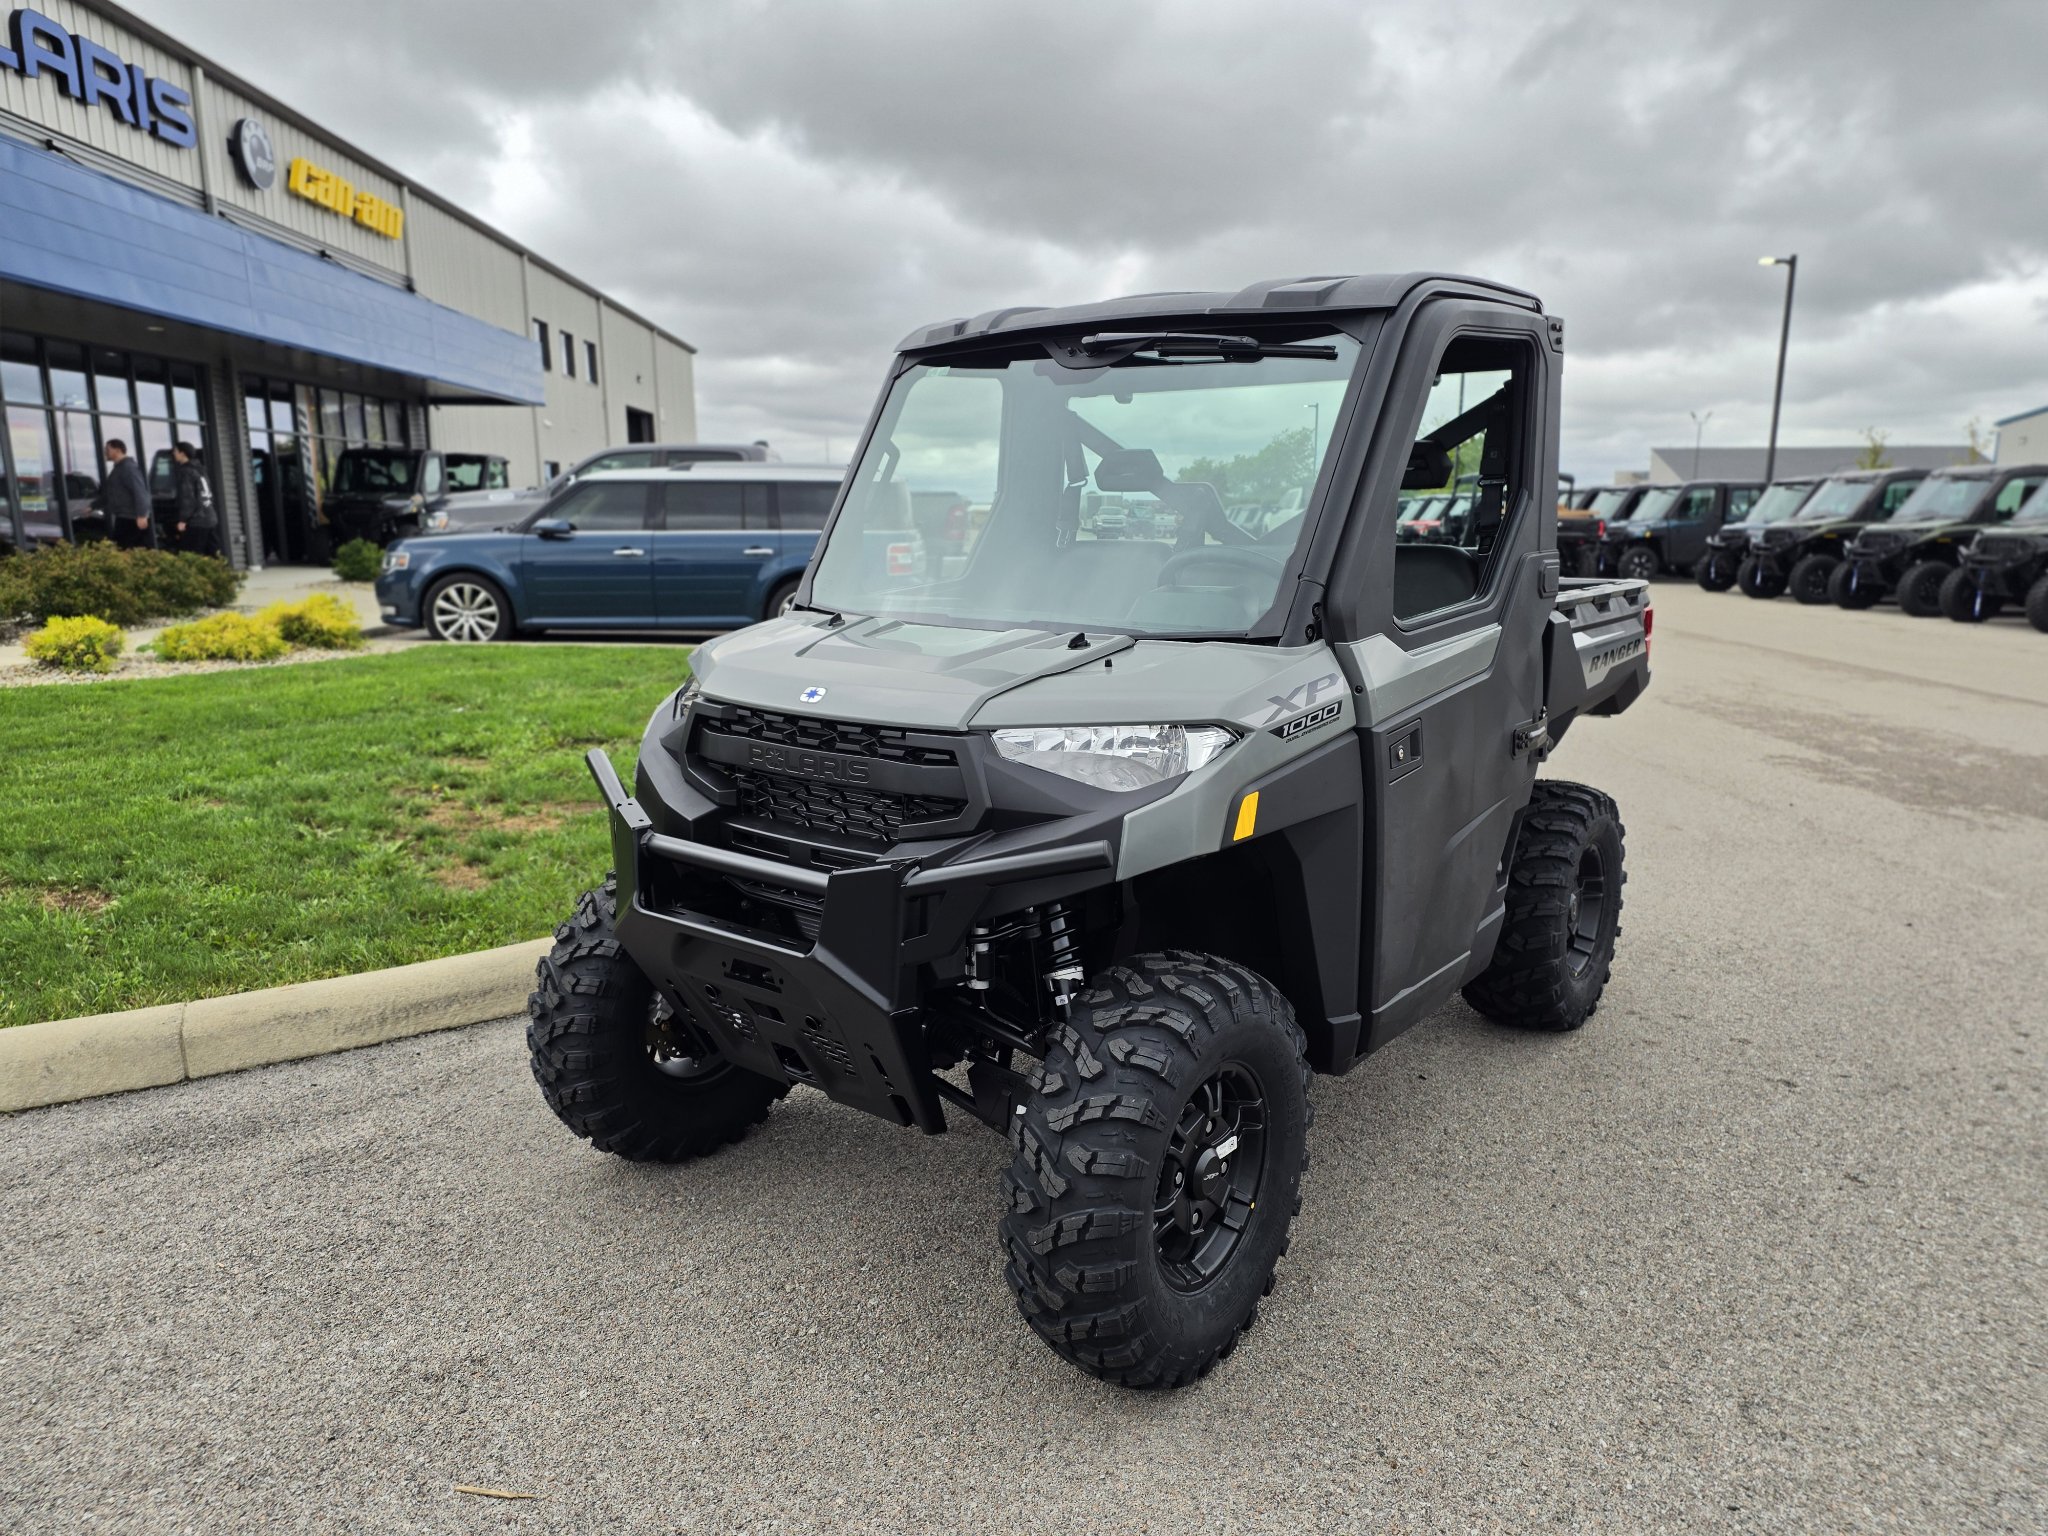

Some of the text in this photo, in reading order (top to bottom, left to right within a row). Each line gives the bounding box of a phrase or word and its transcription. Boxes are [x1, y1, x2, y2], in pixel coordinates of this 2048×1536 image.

[1589, 638, 1641, 673] RANGER
[1263, 673, 1340, 725] XP
[1282, 703, 1339, 738] 1000
[748, 744, 871, 784] POLARIS
